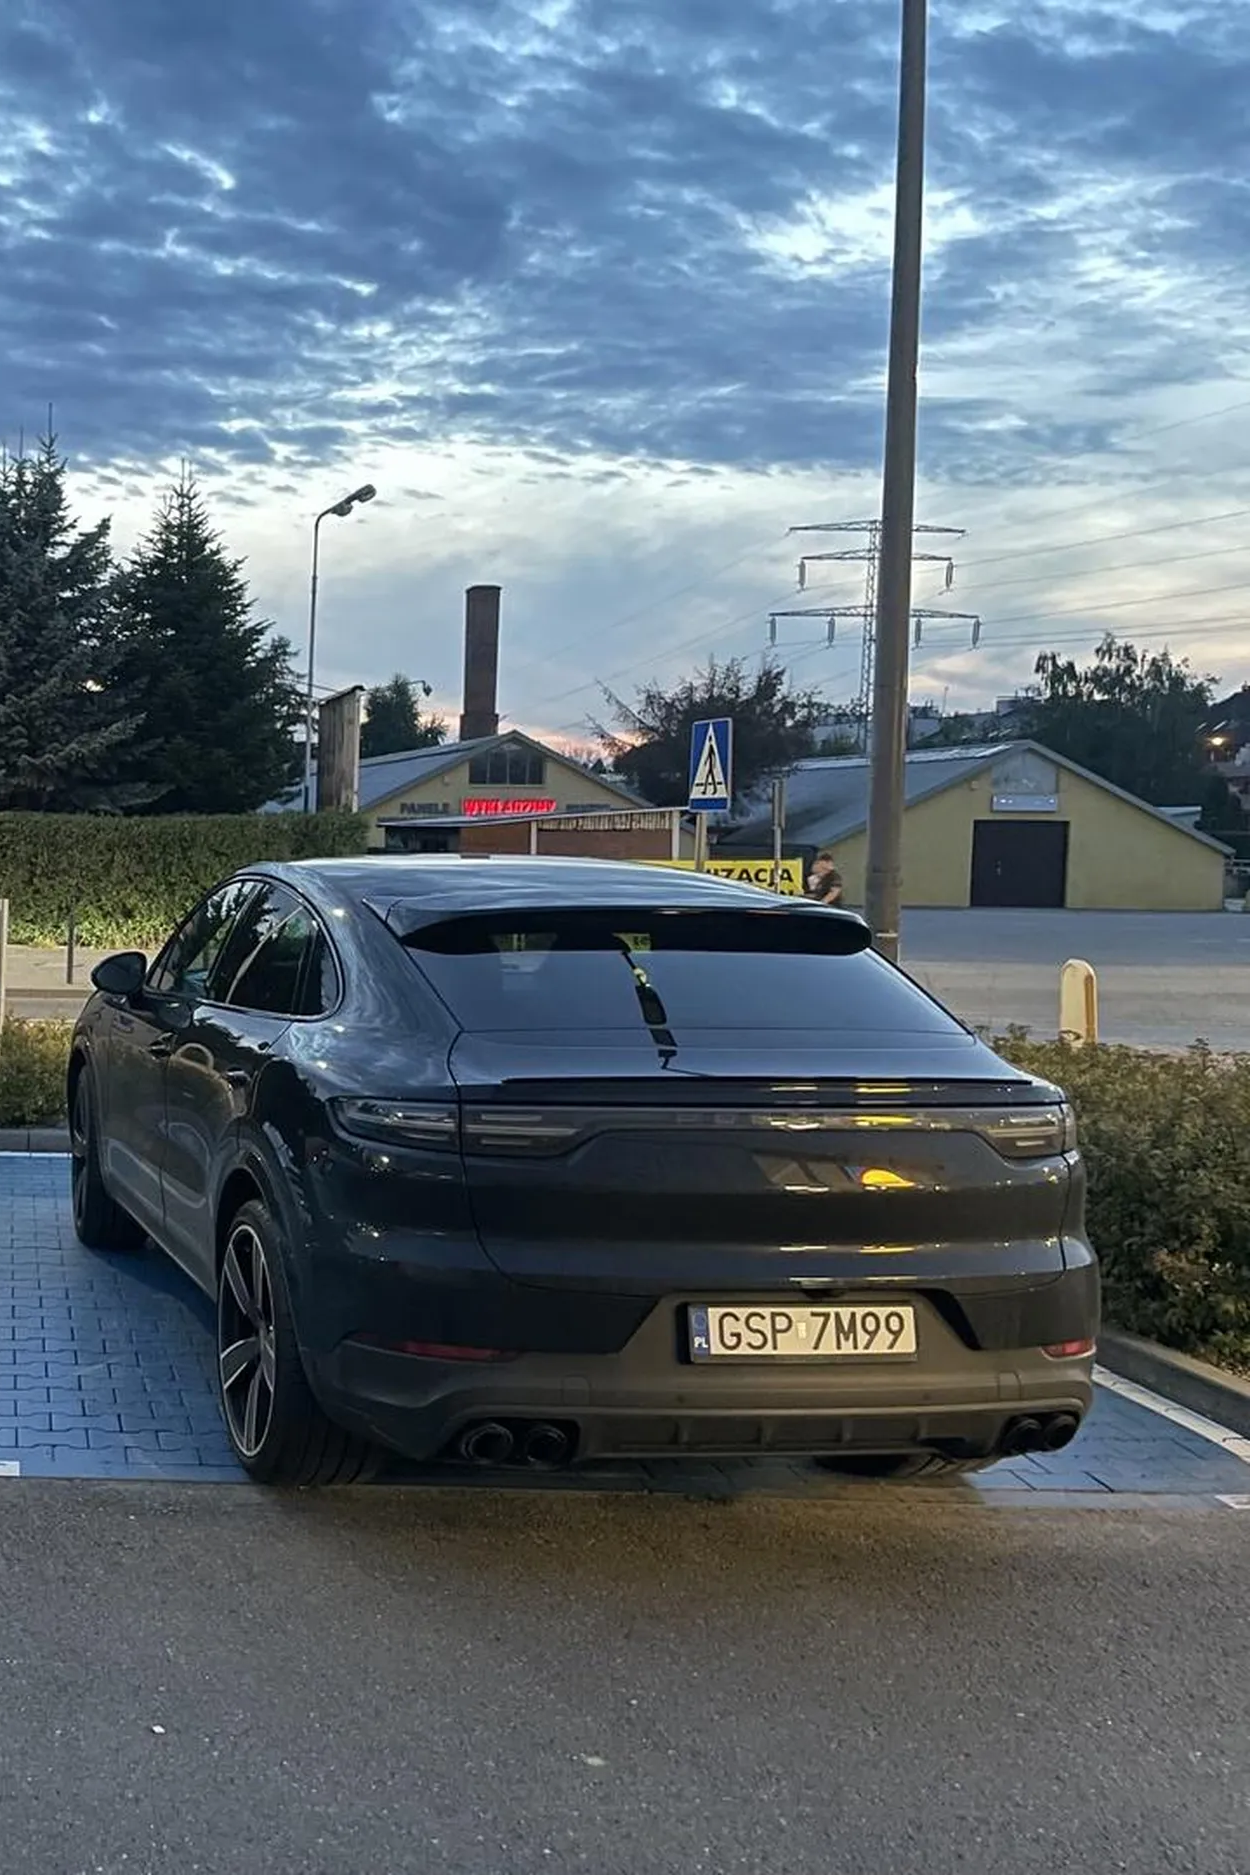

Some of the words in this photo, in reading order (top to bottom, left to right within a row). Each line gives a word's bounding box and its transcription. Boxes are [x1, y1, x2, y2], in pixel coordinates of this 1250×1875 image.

[694, 1336, 709, 1349] PL
[718, 1311, 793, 1351] GSP
[810, 1311, 904, 1351] 7M99
